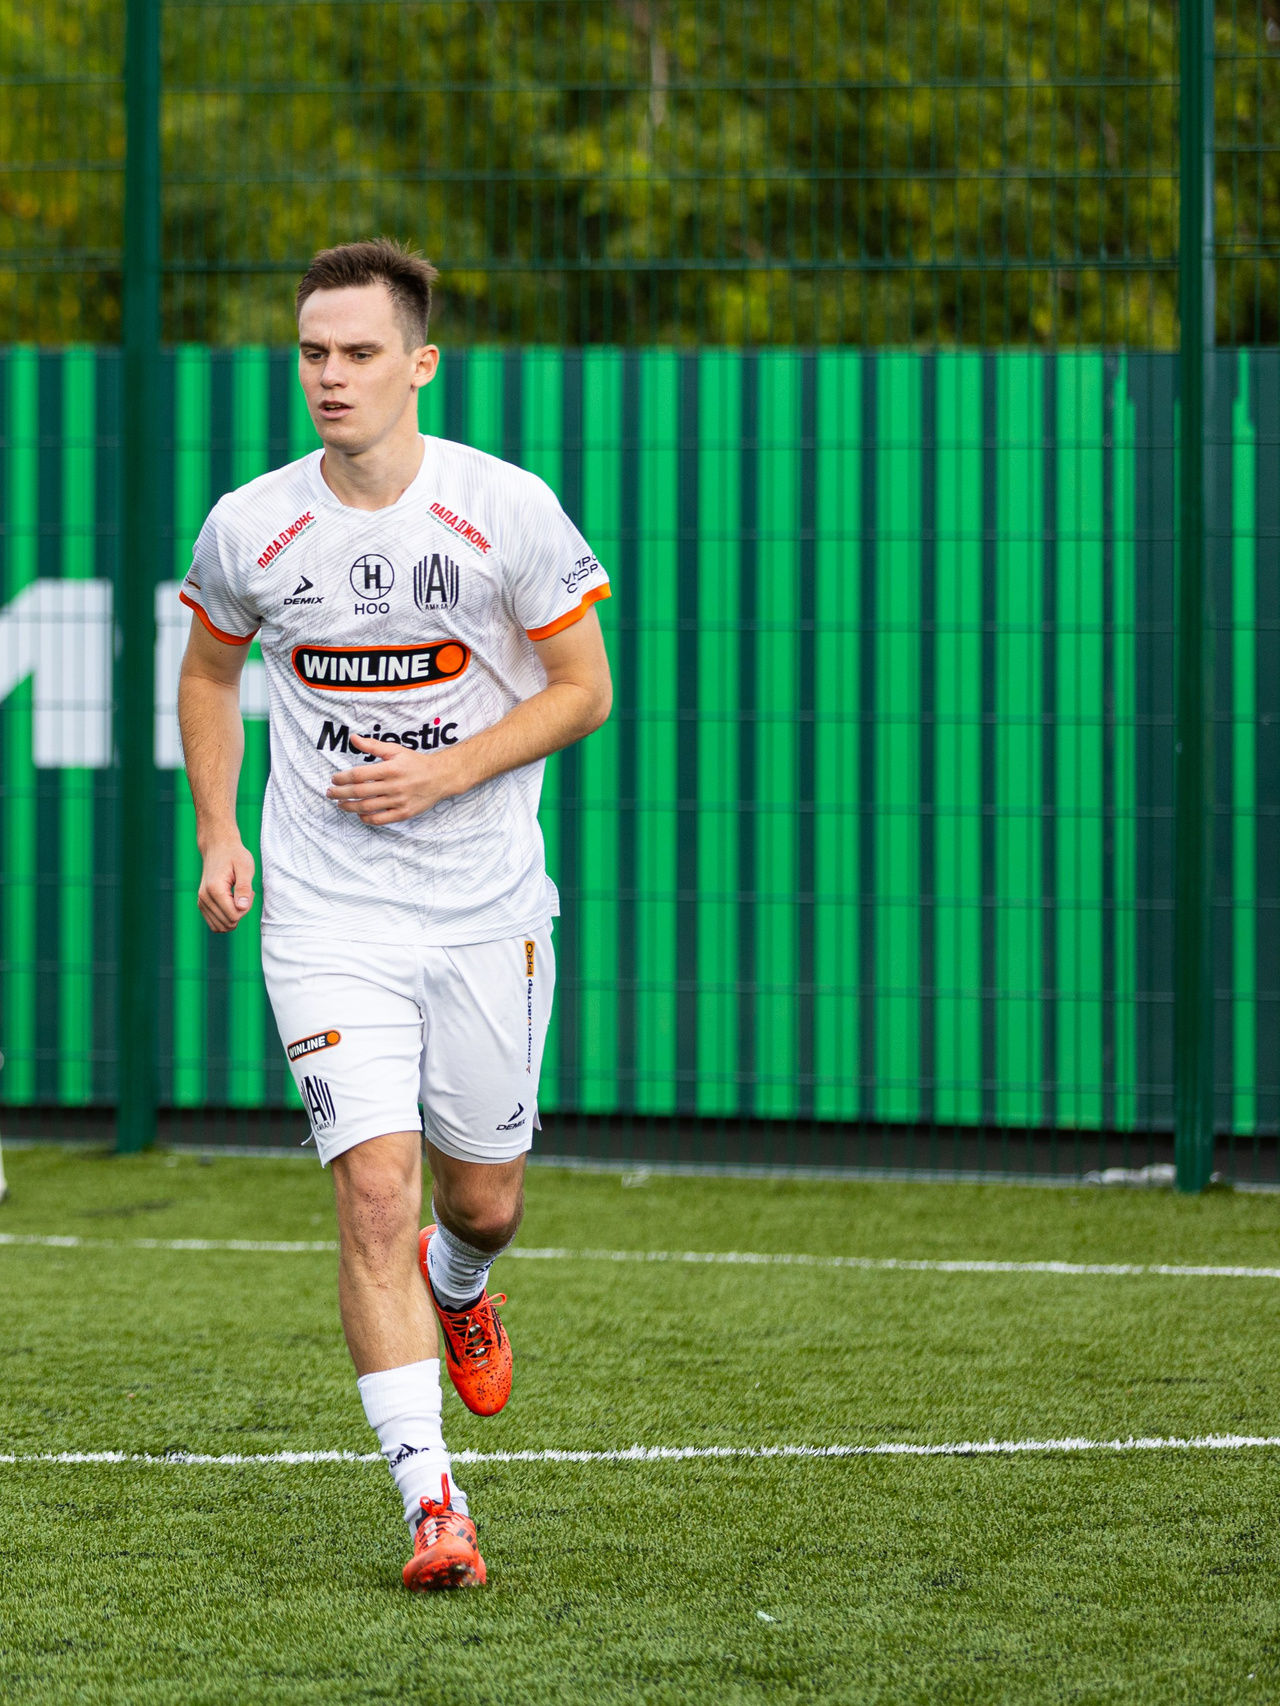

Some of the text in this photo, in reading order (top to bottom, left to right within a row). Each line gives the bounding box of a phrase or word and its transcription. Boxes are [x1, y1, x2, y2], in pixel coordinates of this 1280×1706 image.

[257, 540, 283, 569] ПАПА
[278, 511, 315, 546] ДЖОНС
[429, 502, 459, 528] ПАПА
[454, 519, 492, 554] ДЖОНС
[283, 596, 325, 605] DEMIX
[354, 602, 390, 615] HOO
[303, 653, 430, 682] WINLINE
[525, 942, 534, 976] PRO
[288, 1035, 326, 1059] WINLINE
